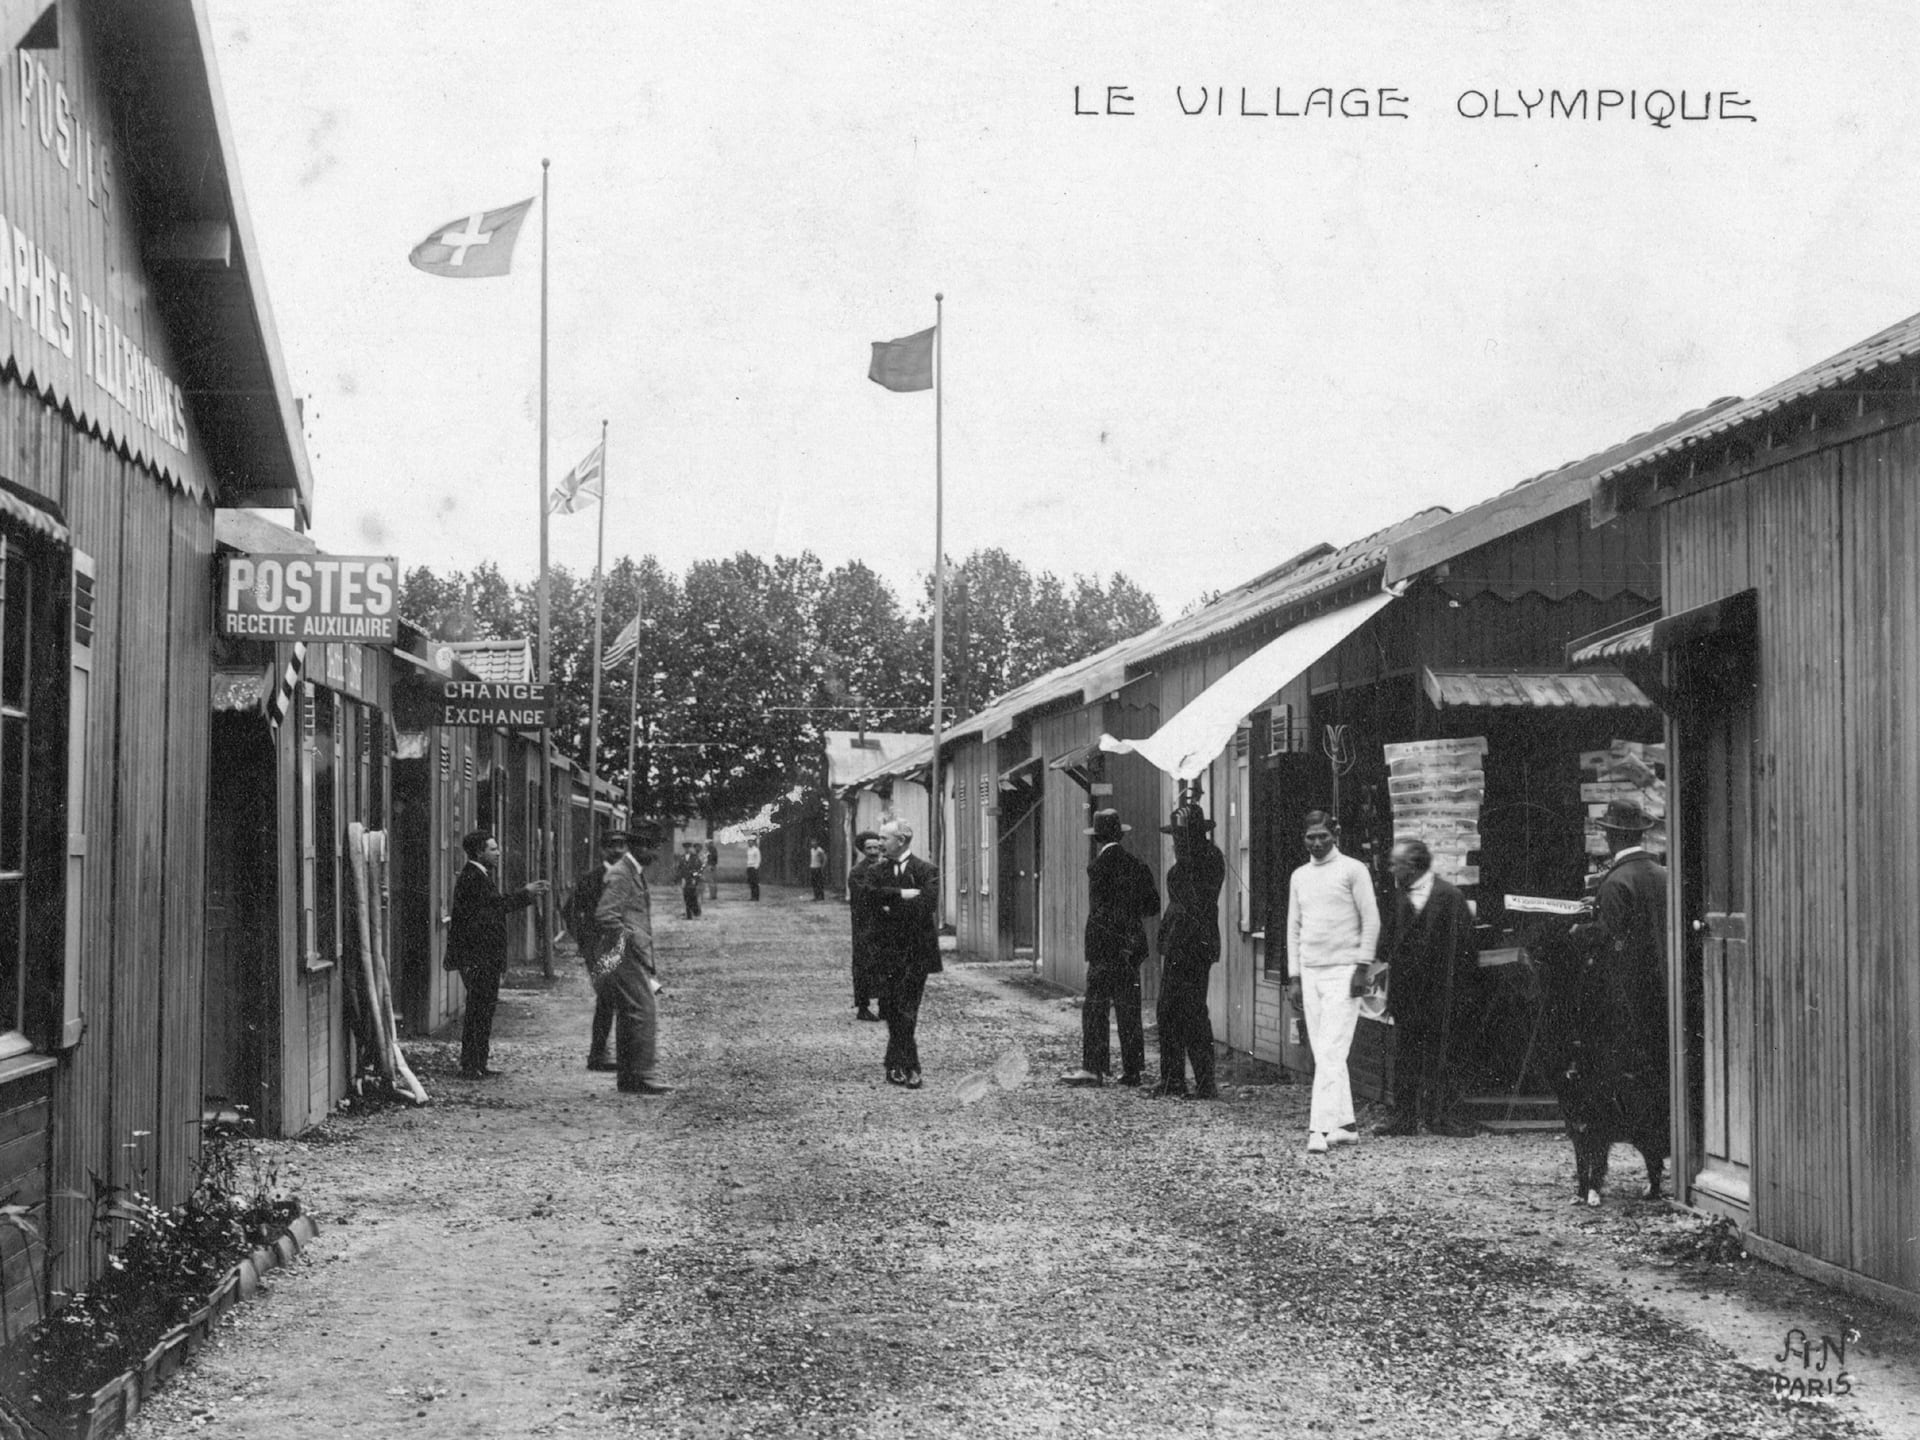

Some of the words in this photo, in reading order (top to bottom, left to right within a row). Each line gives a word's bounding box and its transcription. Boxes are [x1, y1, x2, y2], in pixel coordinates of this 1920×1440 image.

[227, 559, 393, 616] POSTES
[226, 613, 296, 635] RECETTE
[303, 615, 392, 638] AUXILIAIRE
[444, 681, 545, 700] CHANGE
[444, 705, 545, 725] EXCHANGE
